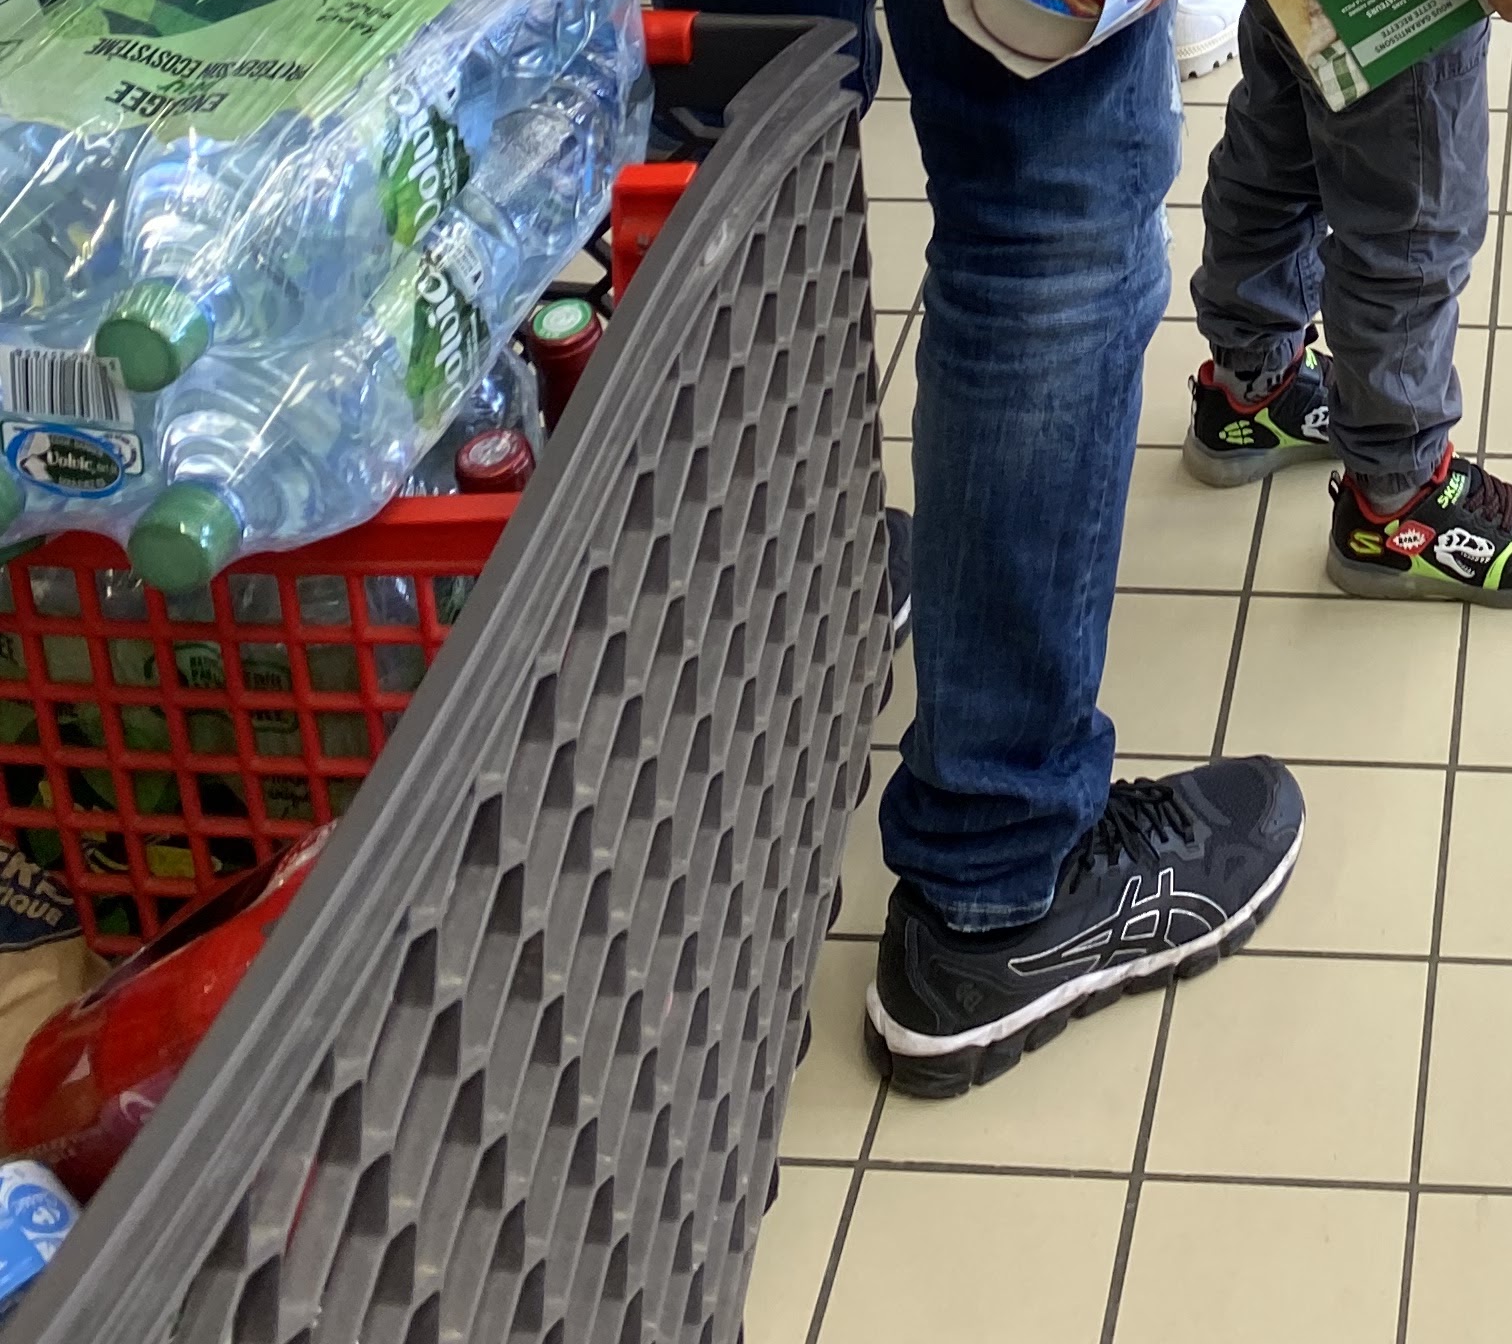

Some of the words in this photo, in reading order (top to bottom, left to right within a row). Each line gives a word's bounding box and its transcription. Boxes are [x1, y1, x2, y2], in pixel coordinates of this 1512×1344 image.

[1429, 0, 1454, 20] NOUS
[1372, 13, 1432, 54] GARANTISSONS
[1378, 13, 1414, 39] RECETTE
